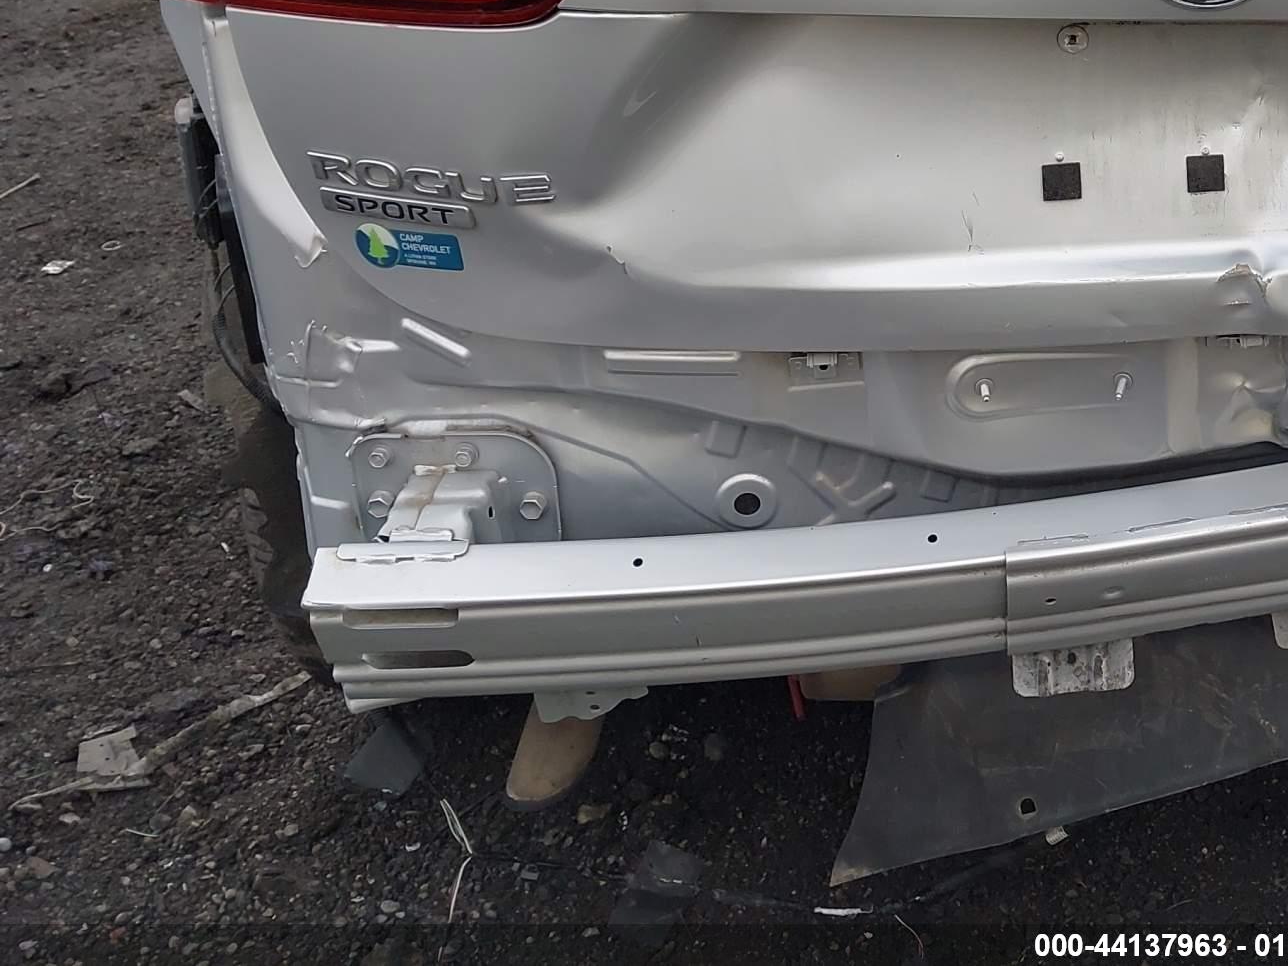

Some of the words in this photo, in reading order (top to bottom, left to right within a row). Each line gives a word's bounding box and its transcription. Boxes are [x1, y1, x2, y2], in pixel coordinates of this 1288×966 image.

[306, 149, 556, 205] ROGUE
[333, 194, 455, 226] SPORT
[399, 233, 424, 243] CAMP
[401, 243, 451, 254] CHEVROLET
